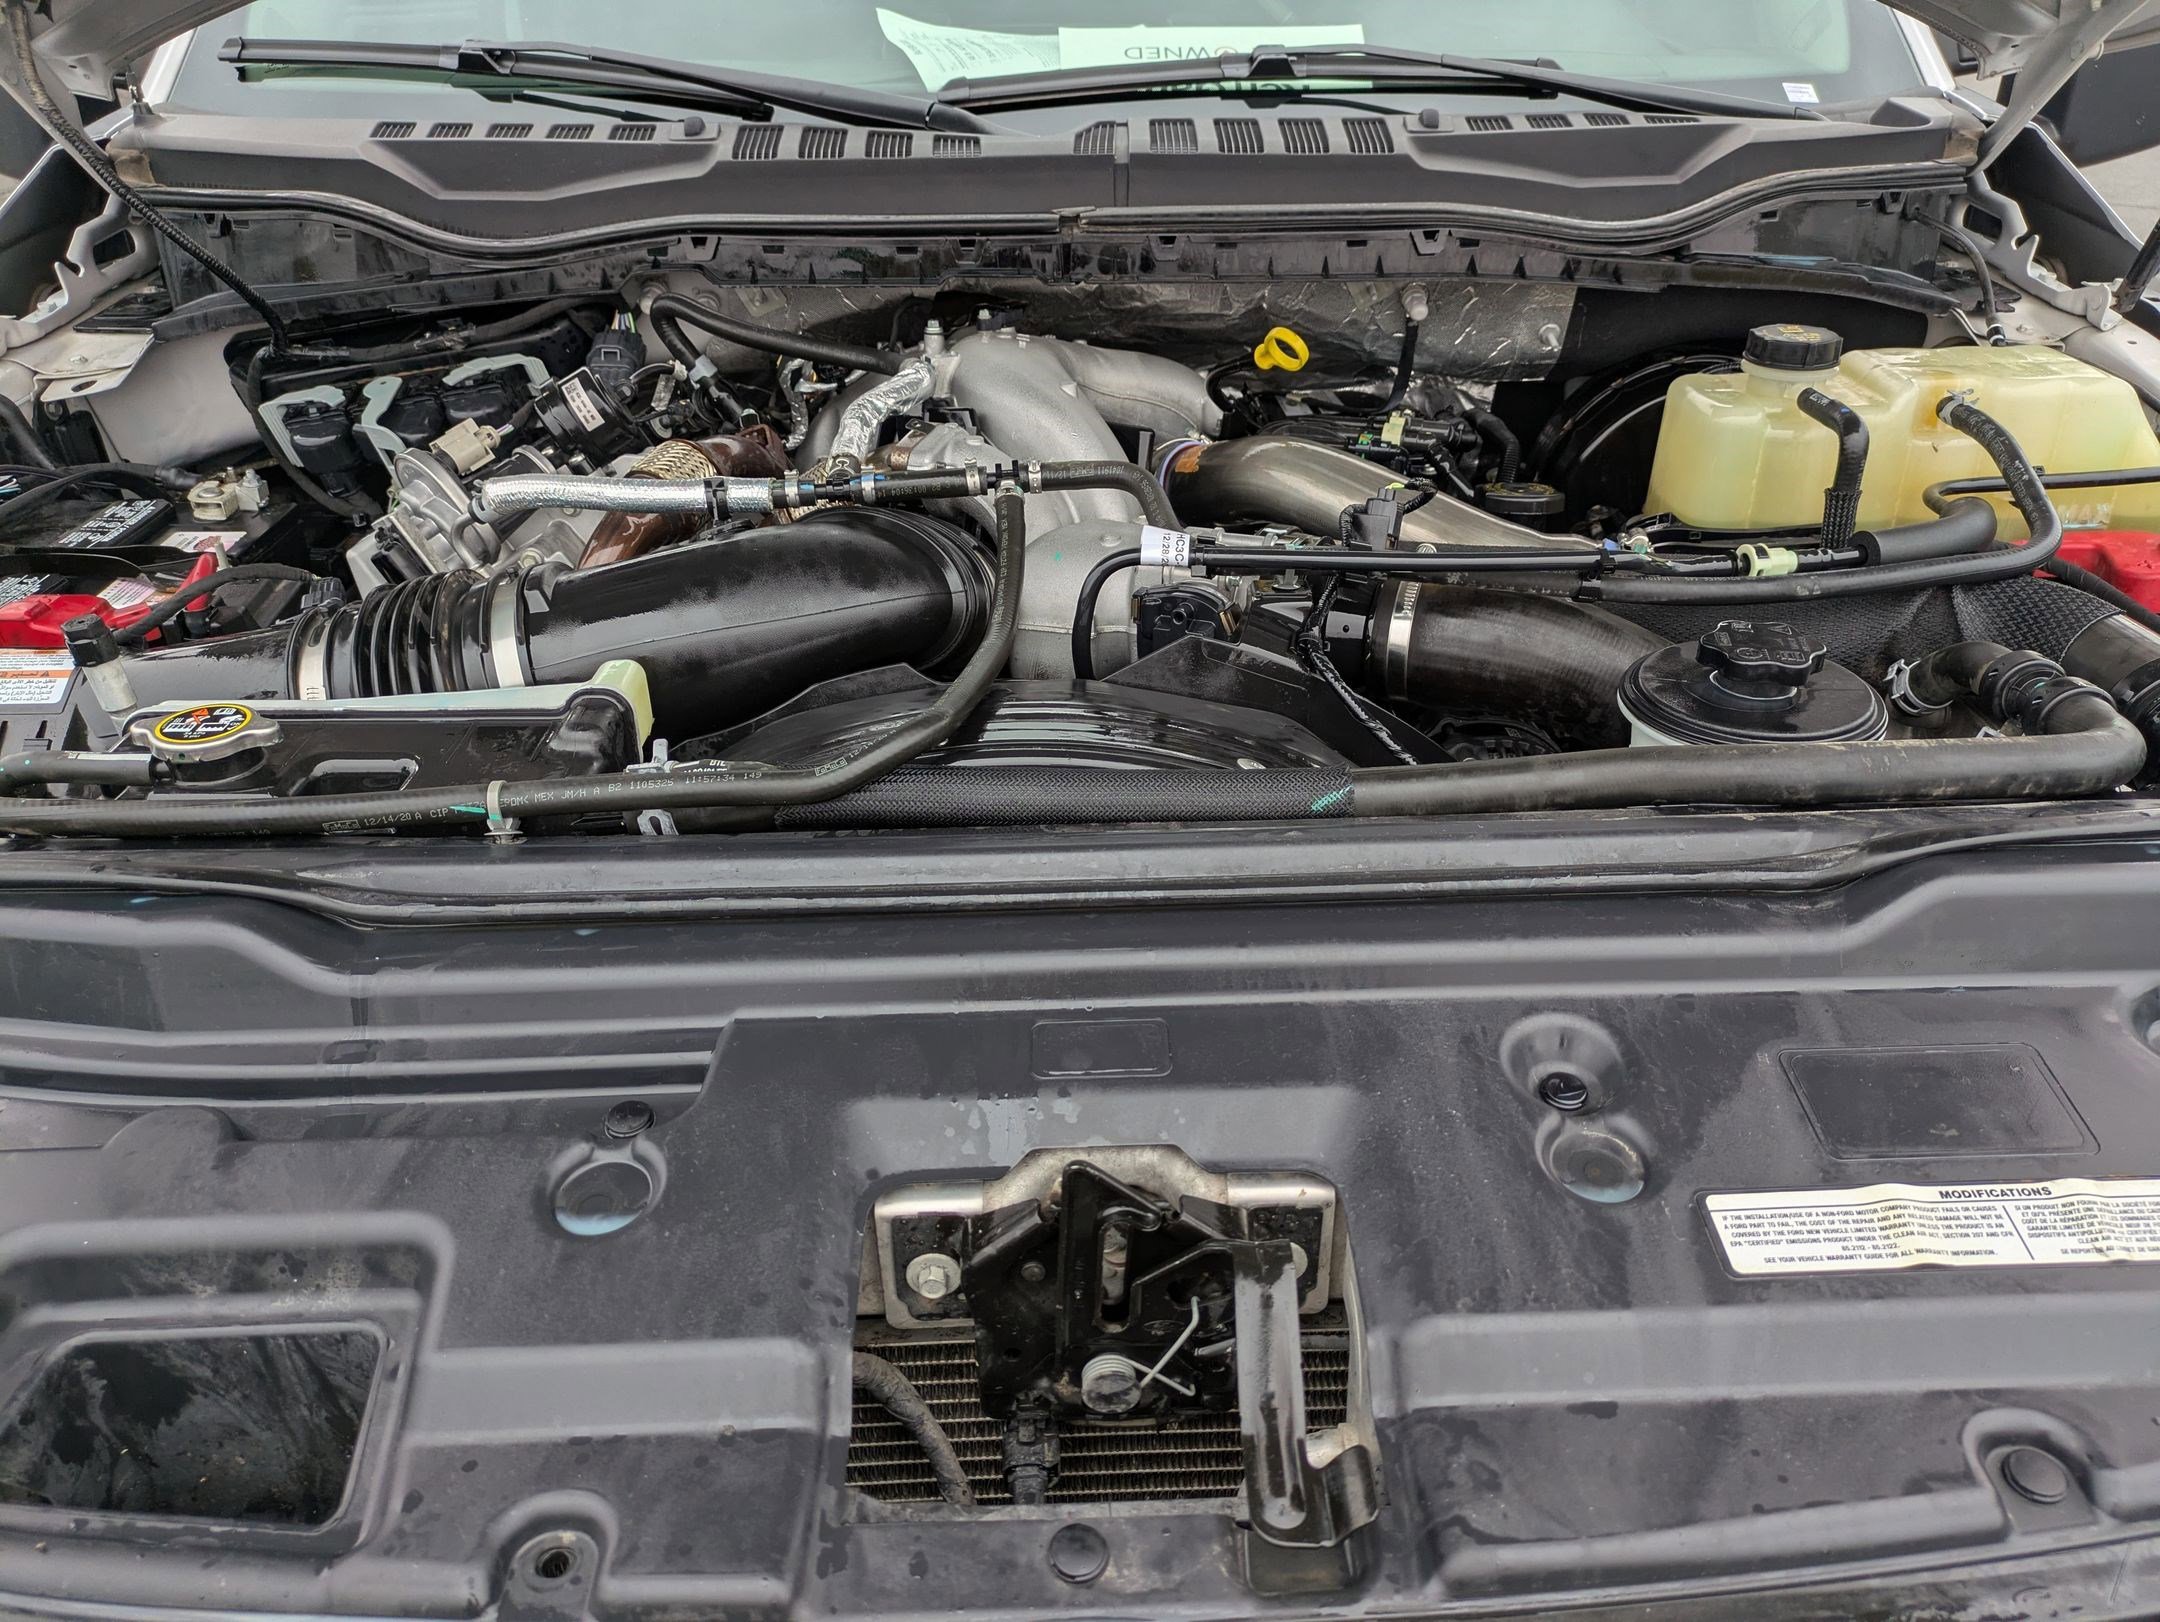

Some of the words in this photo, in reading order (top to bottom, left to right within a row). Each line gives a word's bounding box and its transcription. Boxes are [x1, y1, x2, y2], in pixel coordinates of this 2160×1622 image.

[364, 812, 411, 826] 12/14/20
[430, 807, 449, 818] CIP
[535, 791, 554, 802] MEX
[561, 789, 586, 799] JM/H
[608, 782, 622, 793] B2
[630, 778, 674, 790] 1105325
[685, 772, 736, 785] 11:57:34
[1939, 1187, 2052, 1199] MODIFICATIONS
[2049, 1208, 2081, 1216] PRÉSENTE
[2060, 1214, 2098, 1222] RÉPARATION
[1880, 1222, 1916, 1232] WARRANTY
[1893, 1231, 1915, 1239] CLEAN
[2078, 1236, 2099, 1244] CLEAN
[1827, 1253, 1862, 1261] WARRANTY
[1916, 1248, 1949, 1256] WARRANTY
